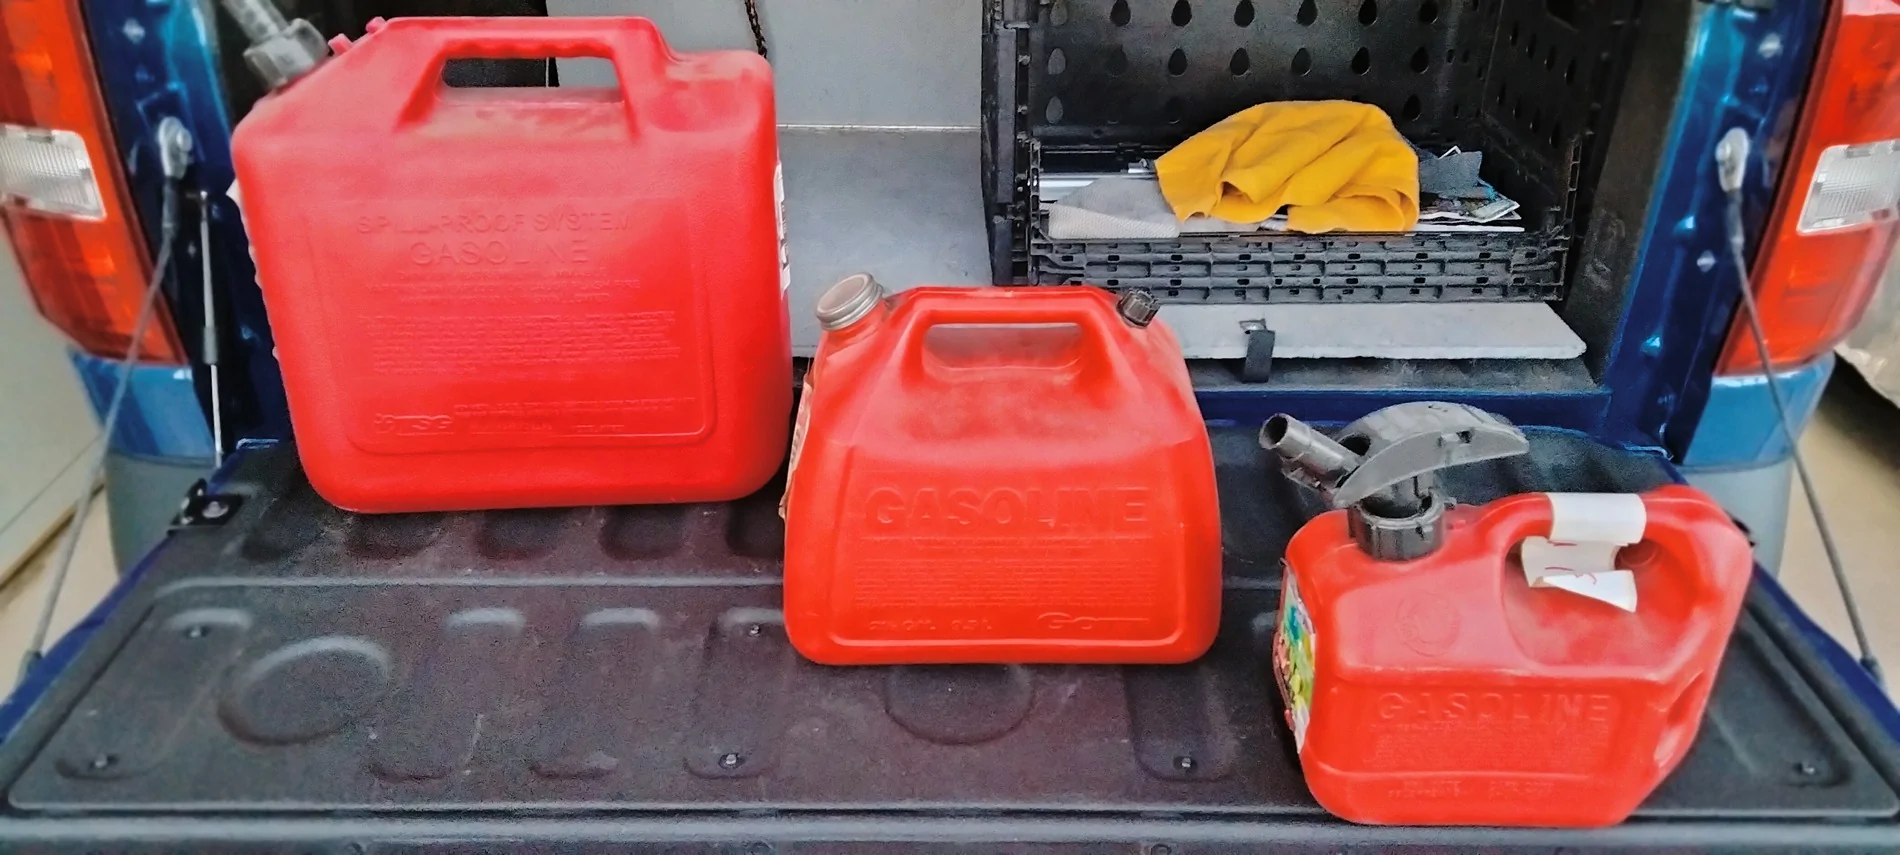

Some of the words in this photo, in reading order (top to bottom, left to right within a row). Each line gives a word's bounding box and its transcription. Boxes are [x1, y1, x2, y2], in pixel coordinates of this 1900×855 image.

[533, 211, 633, 233] SYSTEM
[409, 238, 590, 266] GASOLINE
[864, 485, 1151, 533] GASOLINE
[1378, 691, 1612, 721] GASOLINE
